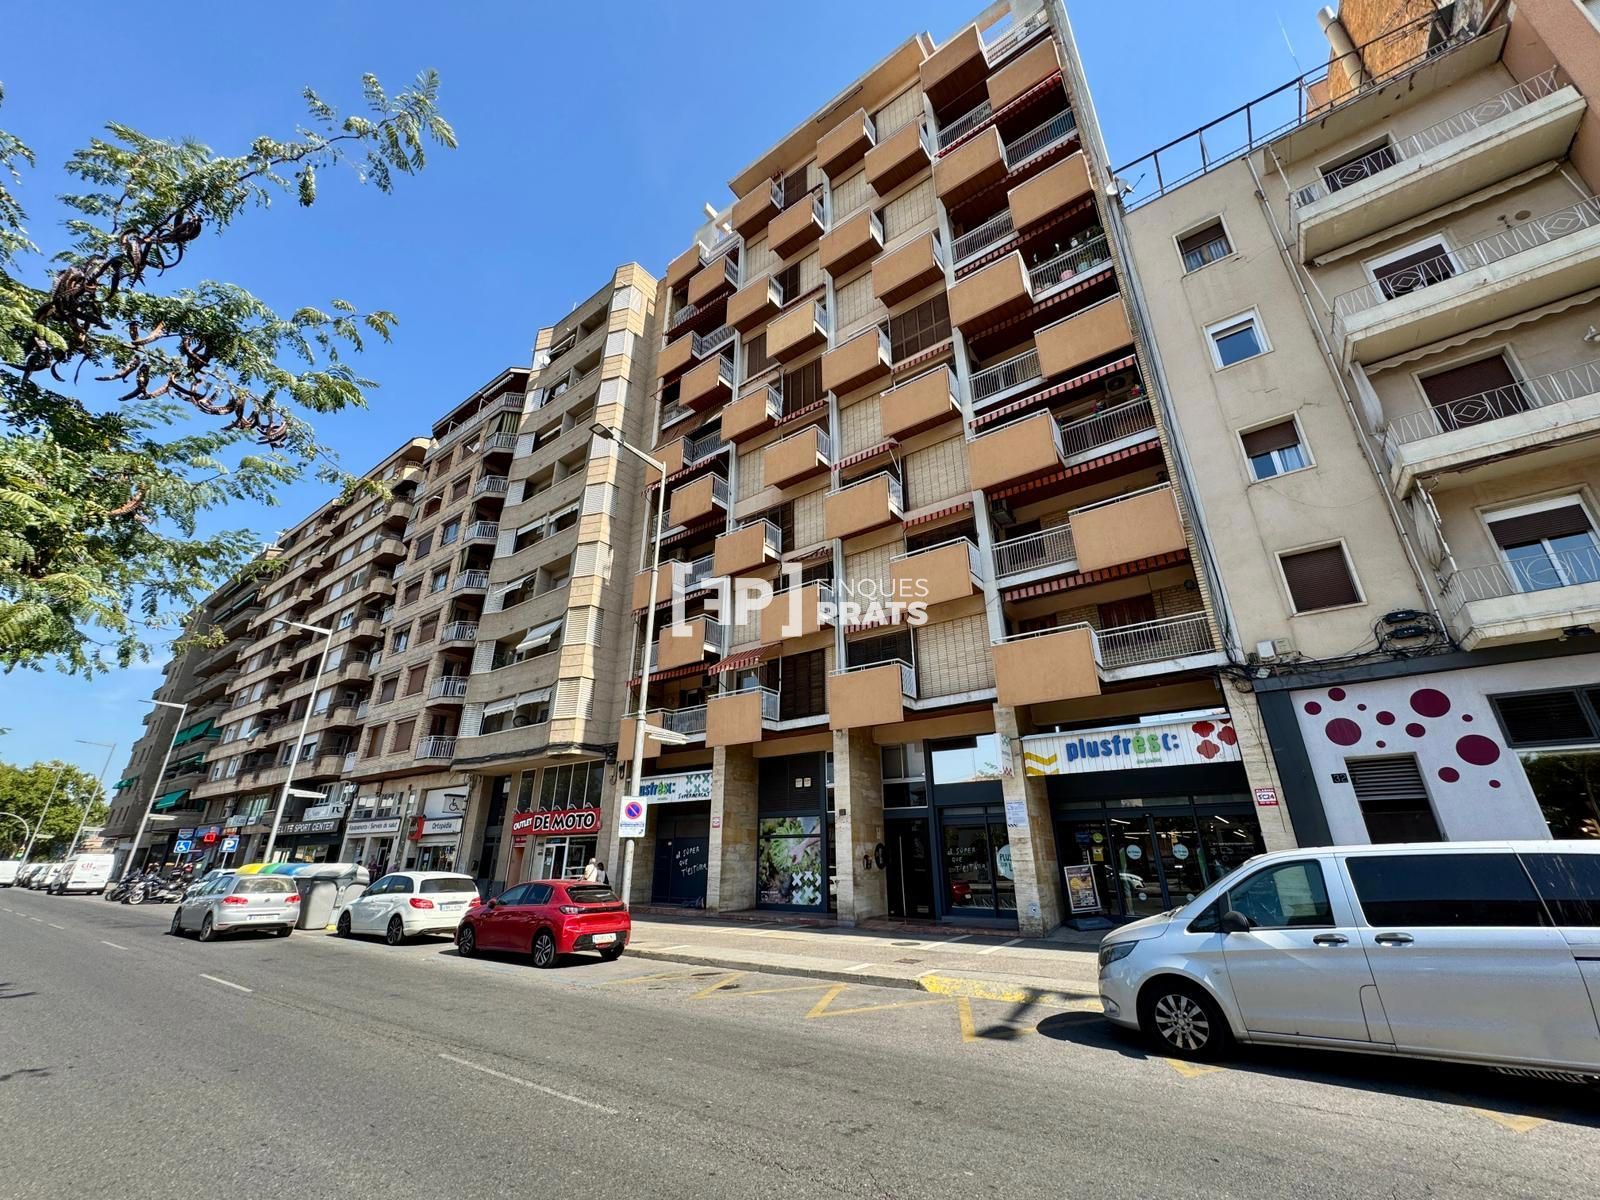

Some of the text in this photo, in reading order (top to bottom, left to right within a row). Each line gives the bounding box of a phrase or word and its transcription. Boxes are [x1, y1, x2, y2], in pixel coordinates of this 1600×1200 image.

[294, 823, 312, 833] SPORT
[311, 821, 335, 832] CENTER
[513, 811, 597, 831] OUTLET DE MOTO
